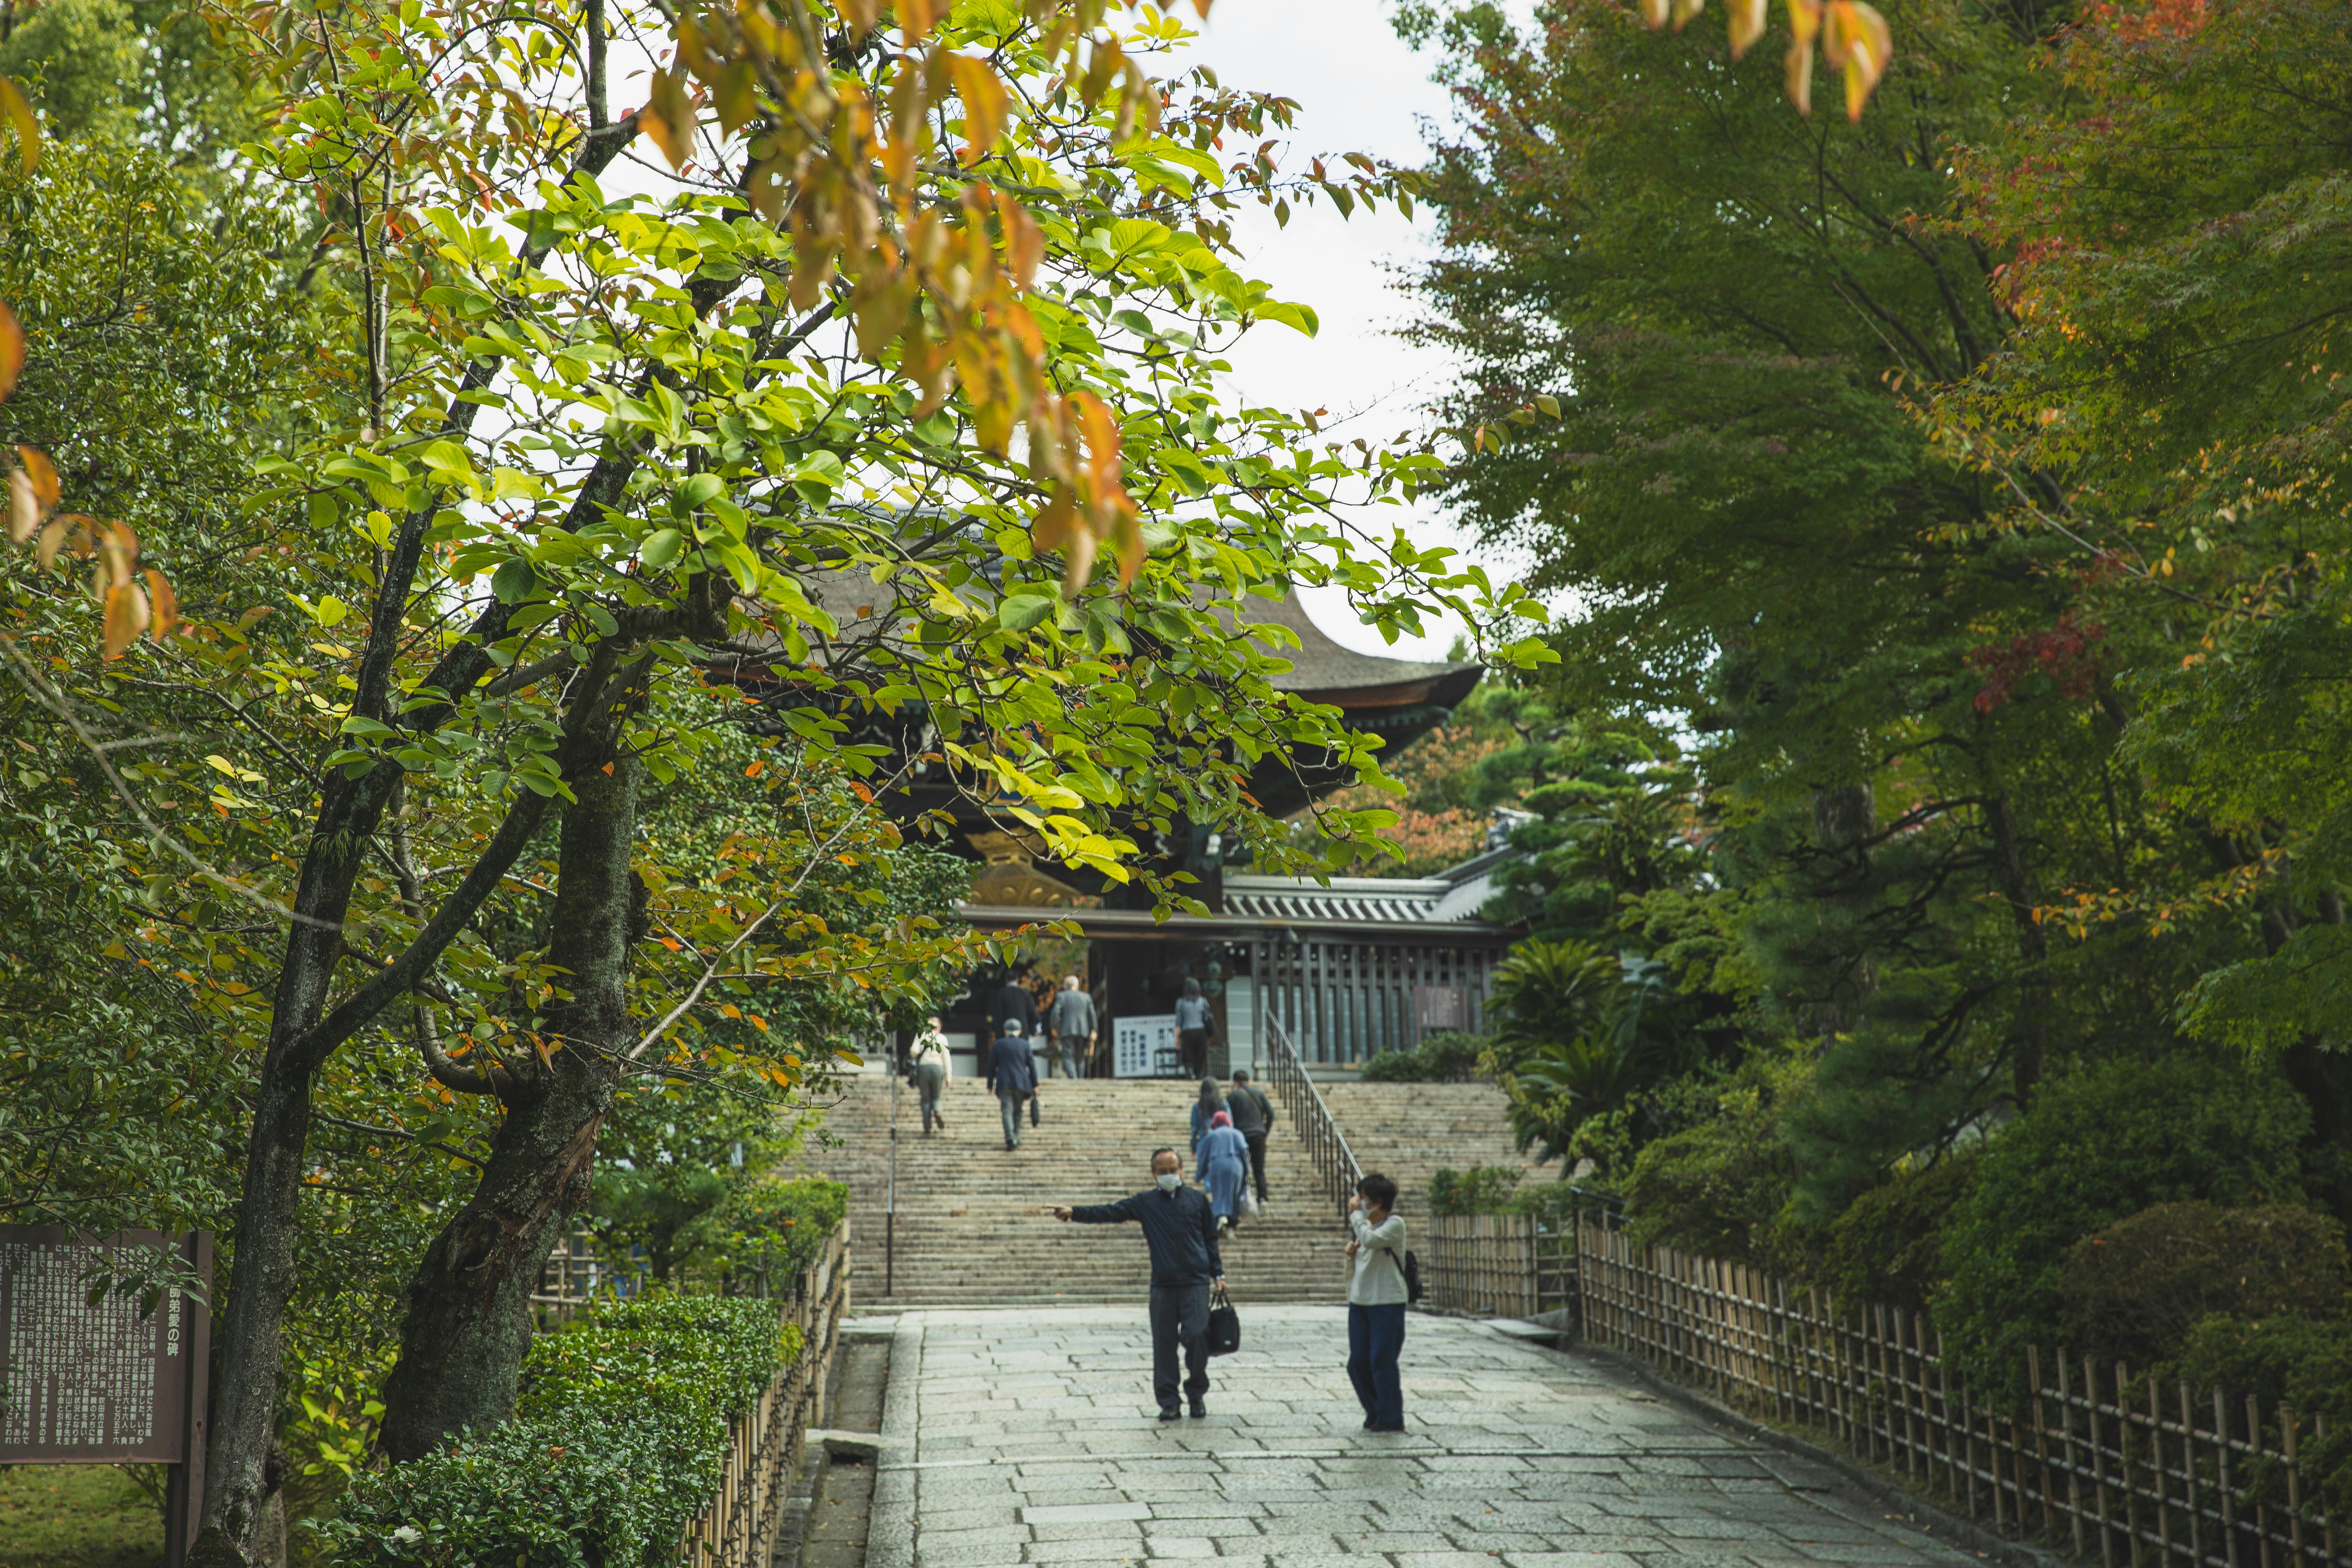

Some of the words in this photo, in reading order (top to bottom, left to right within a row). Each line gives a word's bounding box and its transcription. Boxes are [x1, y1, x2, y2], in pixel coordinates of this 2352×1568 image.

[167, 1286, 181, 1356] 師弟愛の碑
